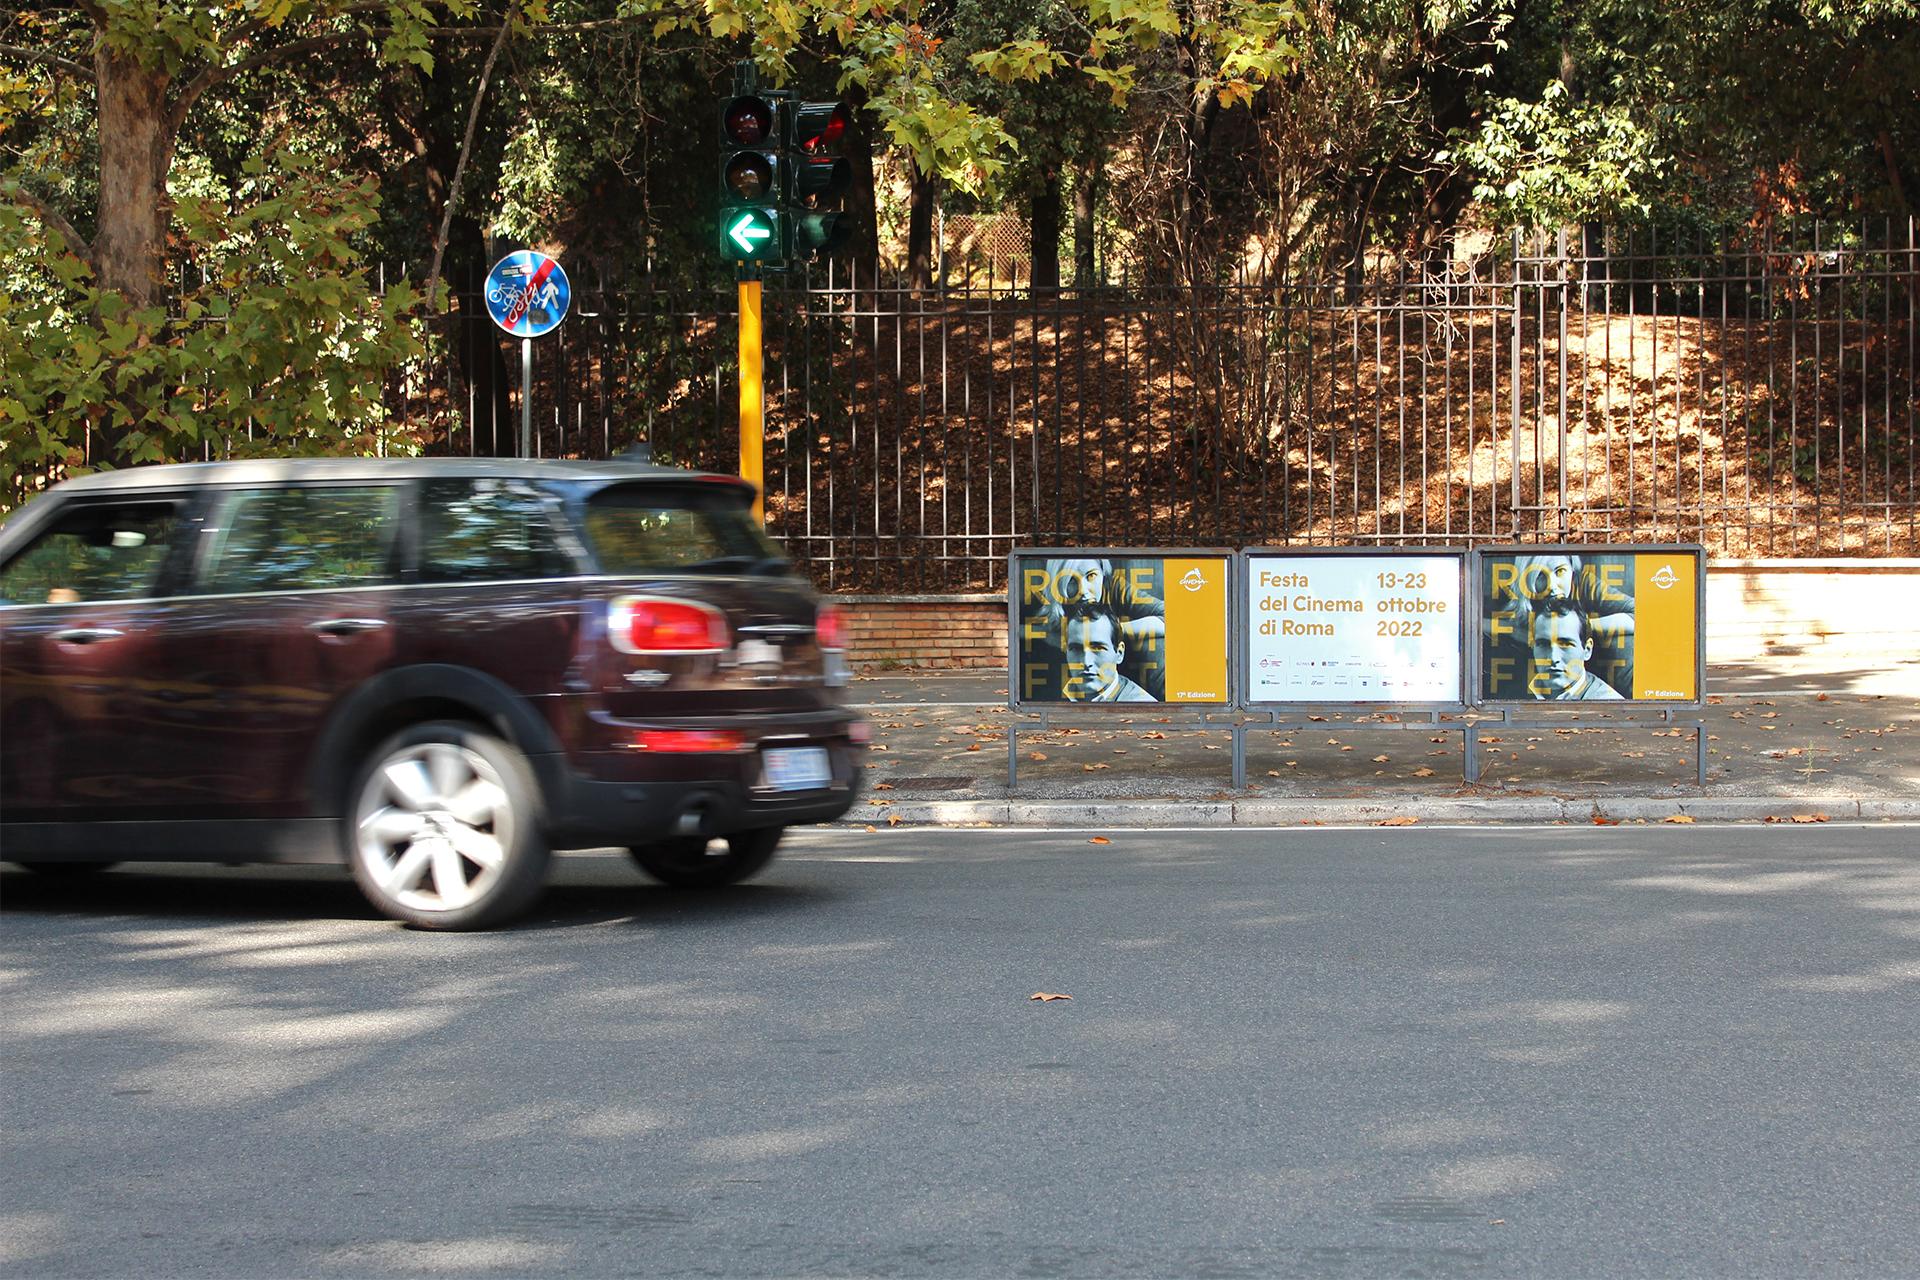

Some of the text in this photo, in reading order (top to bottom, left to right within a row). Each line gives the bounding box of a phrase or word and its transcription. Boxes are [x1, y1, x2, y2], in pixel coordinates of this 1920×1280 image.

[1023, 568, 1154, 605] ROME
[1260, 571, 1309, 588] Festa
[1376, 572, 1427, 589] 13-23
[1491, 563, 1625, 601] ROME
[1259, 595, 1364, 612] del Cinema
[1376, 597, 1447, 613] ottobre
[1259, 619, 1335, 636] di Roma
[1376, 620, 1423, 637] 2022
[1187, 691, 1216, 699] Edizione
[1655, 690, 1684, 698] Edizione
